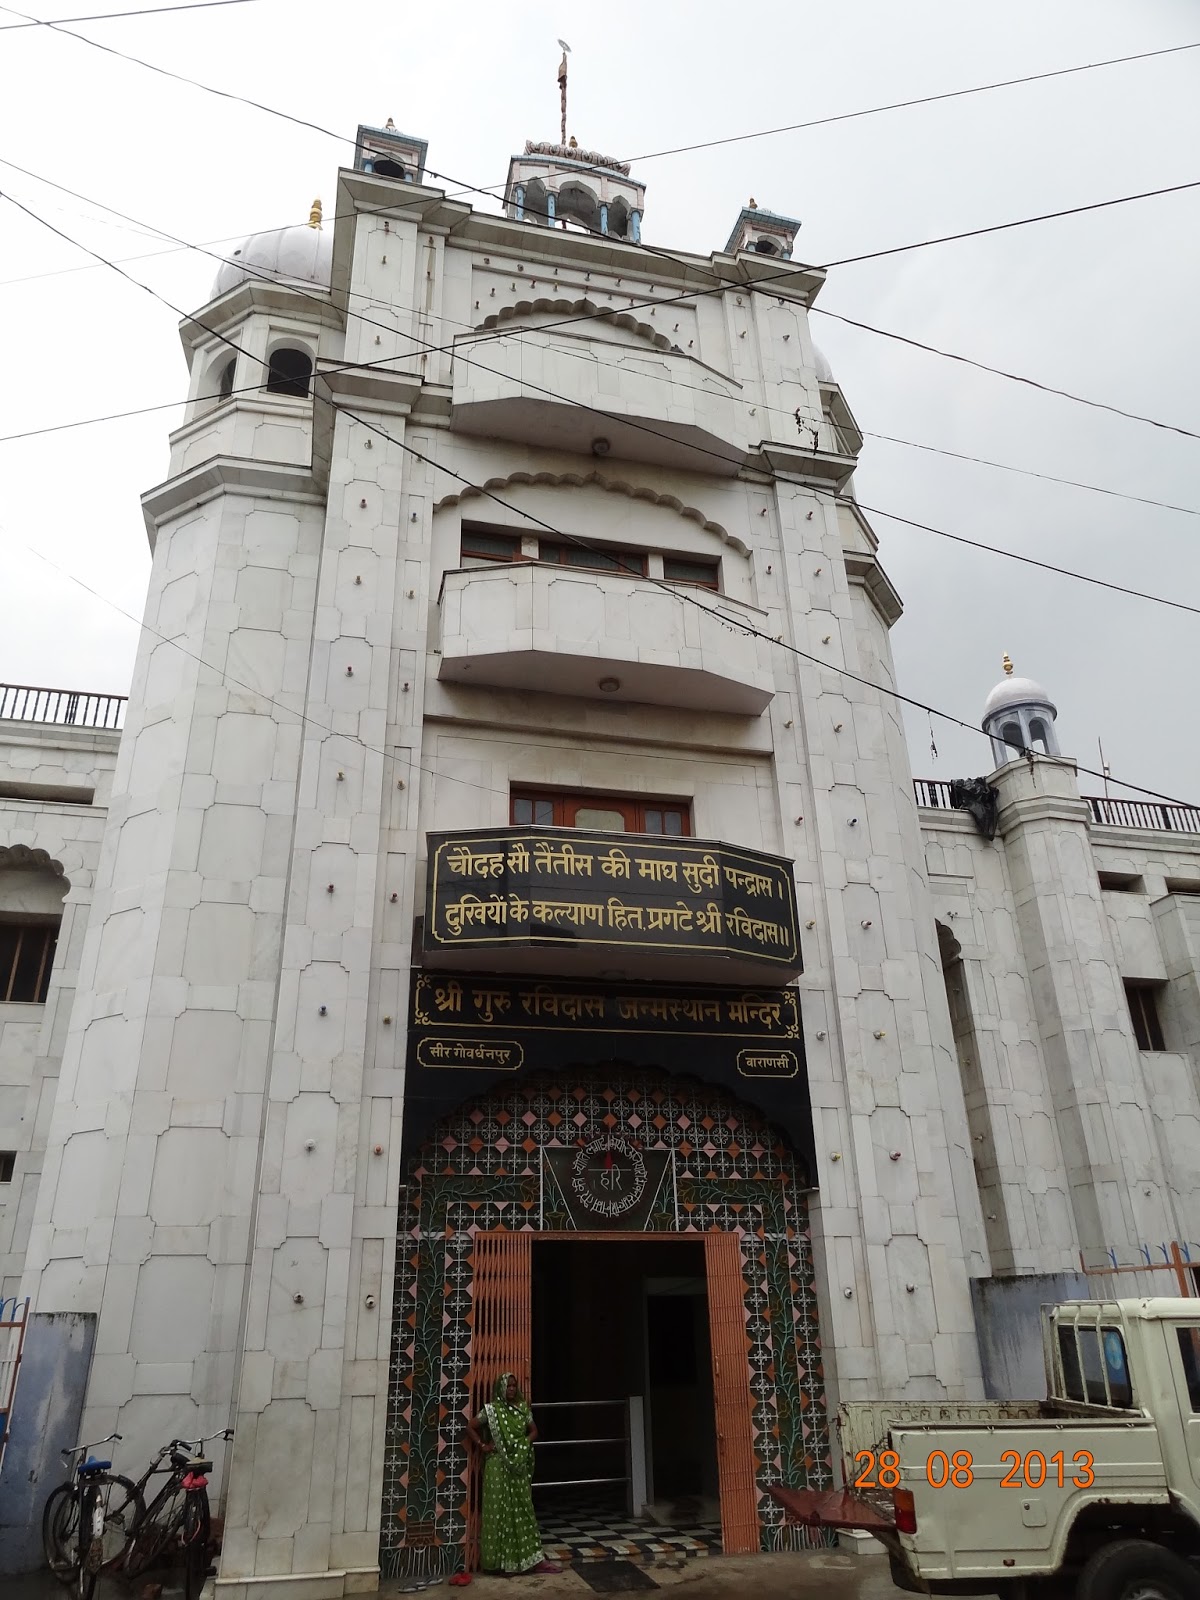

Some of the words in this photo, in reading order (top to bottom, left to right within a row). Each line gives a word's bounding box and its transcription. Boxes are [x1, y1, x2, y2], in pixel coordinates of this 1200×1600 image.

[447, 847, 504, 878] चौदह
[507, 843, 530, 874] सौ
[533, 842, 594, 877] तैंतीस
[598, 849, 631, 880] की
[635, 859, 677, 882] माघ
[682, 855, 719, 893] सुदी
[723, 866, 772, 898] पन्द्रास
[445, 894, 507, 936] दुखियों
[509, 893, 529, 923] के
[532, 901, 604, 927] कल्याण
[647, 901, 693, 931] प्रगटे
[696, 903, 722, 934] श्री
[434, 980, 463, 1012] श्री
[472, 990, 511, 1022] गुरु
[519, 985, 605, 1021] रविदास
[616, 997, 720, 1023] जन्मस्थान
[727, 994, 781, 1030] मन्दिर
[429, 1042, 453, 1059] सीर
[454, 1043, 511, 1065] गोवर्धनपुर
[745, 1054, 789, 1069] वाराणसी
